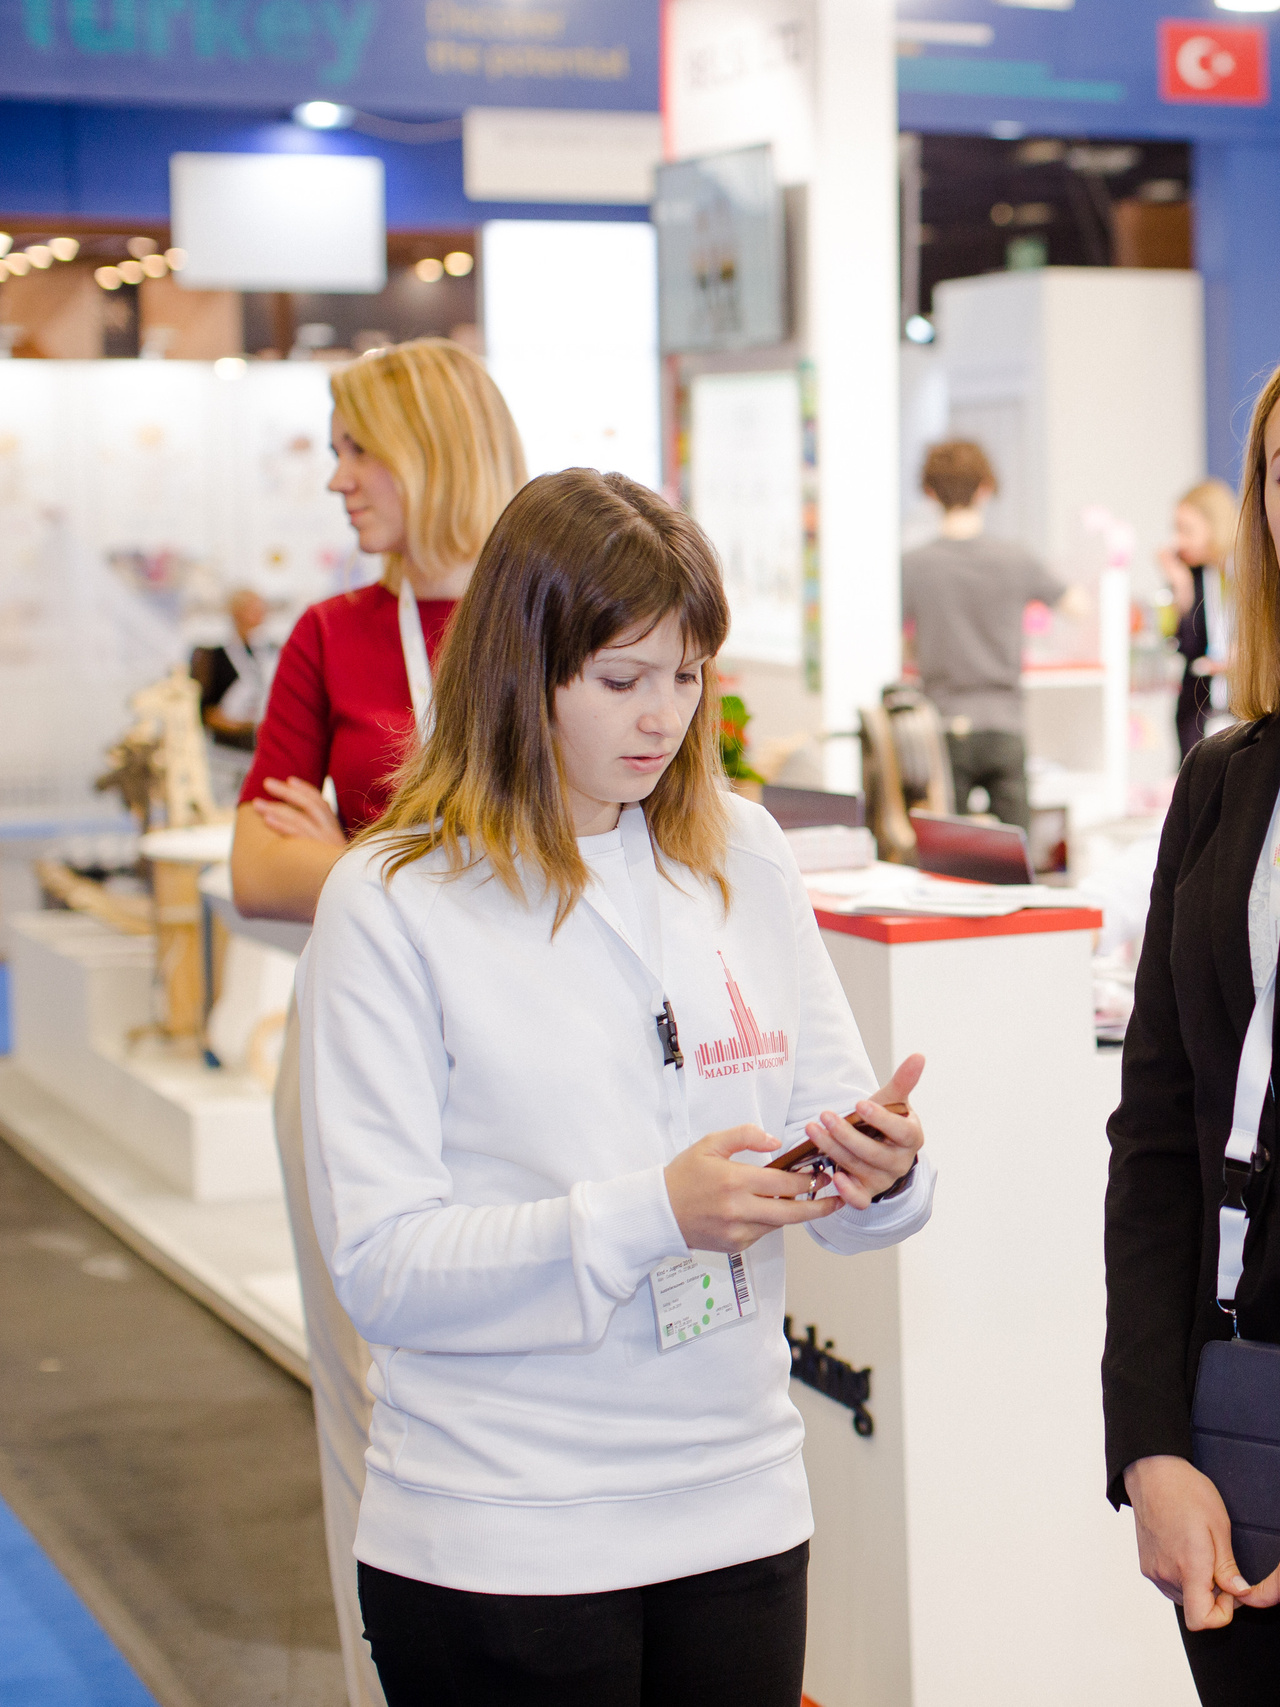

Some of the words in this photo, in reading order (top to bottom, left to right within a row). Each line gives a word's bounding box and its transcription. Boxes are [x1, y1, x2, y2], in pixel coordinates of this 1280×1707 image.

[705, 1064, 740, 1079] MADE
[742, 1061, 754, 1072] IN
[758, 1057, 785, 1070] MOSCOW
